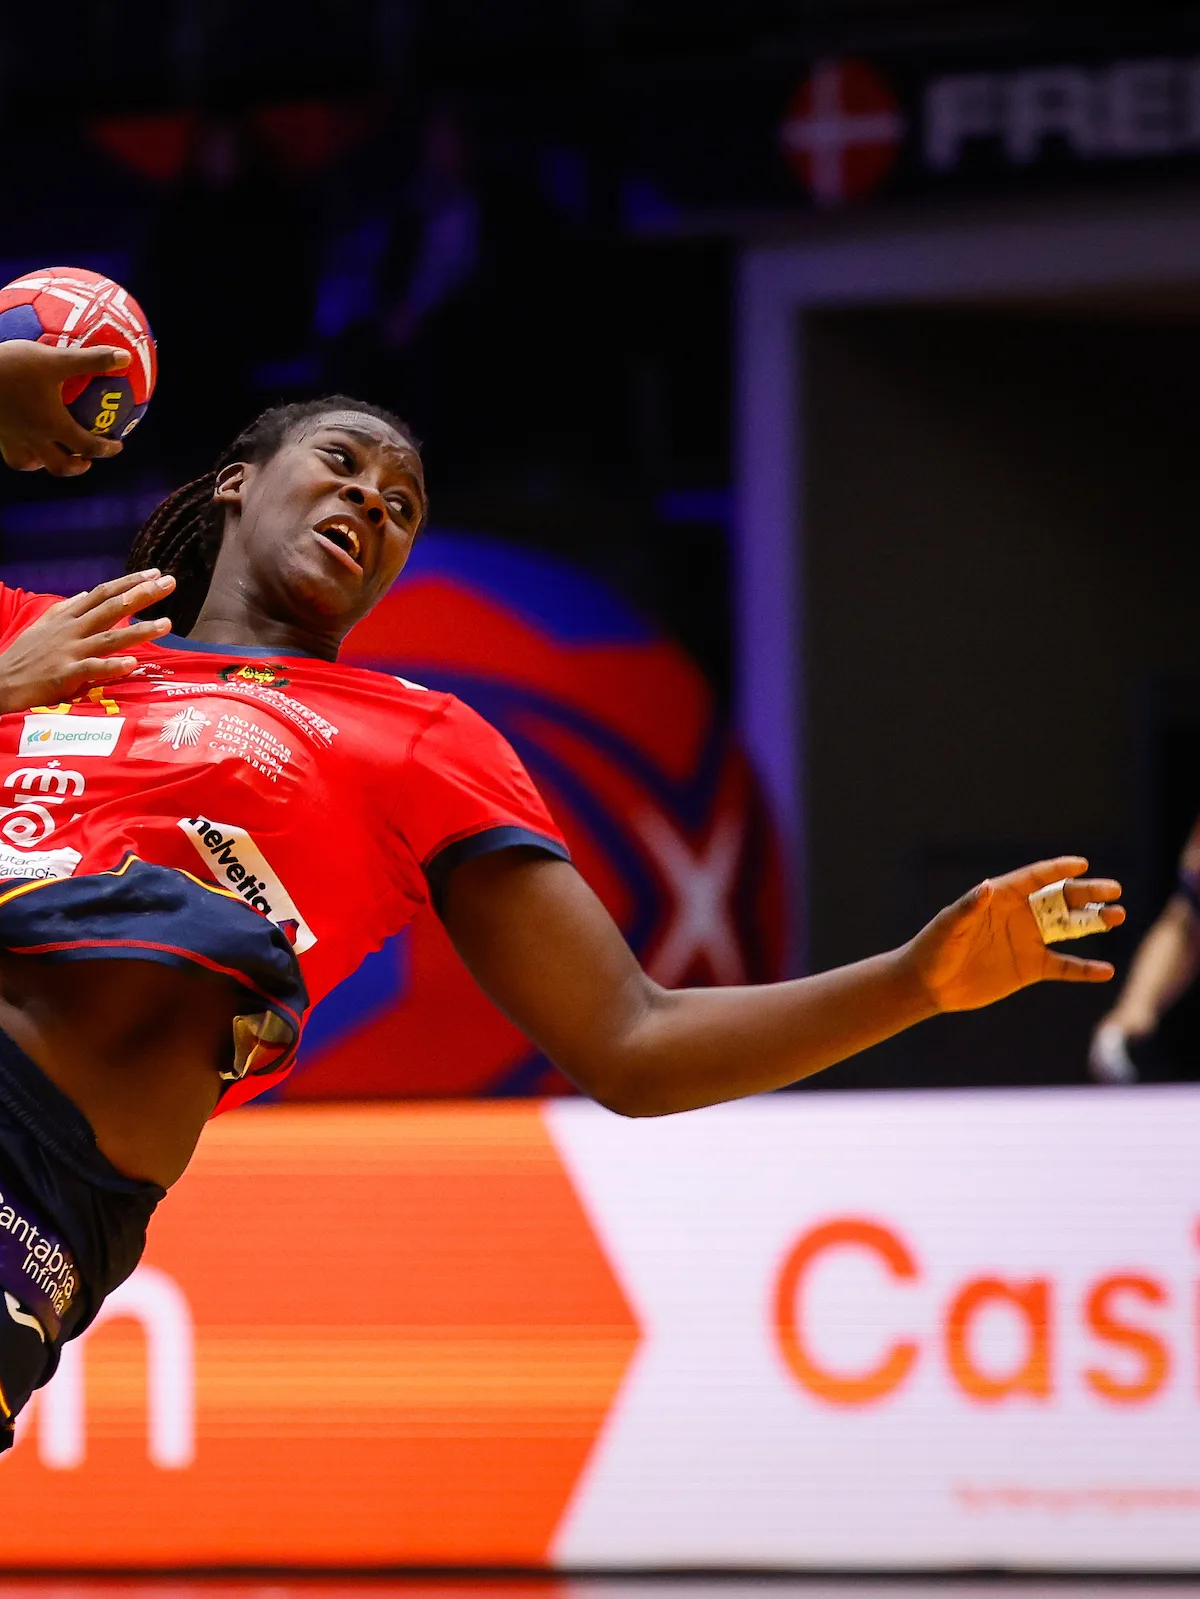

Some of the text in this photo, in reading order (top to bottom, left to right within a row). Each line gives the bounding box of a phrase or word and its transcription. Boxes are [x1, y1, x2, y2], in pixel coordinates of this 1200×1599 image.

[167, 683, 254, 697] PATRIMONIO
[258, 693, 313, 738] MUNDIAL
[53, 731, 113, 742] Iberdrola
[217, 722, 290, 764] LEBANIEGO
[220, 714, 292, 757] AÑO JUBILAR
[208, 741, 279, 783] CANTABRIA
[188, 819, 272, 916] helvetia
[22, 1253, 64, 1317] Infinita
[771, 1215, 1200, 1408] Cas
